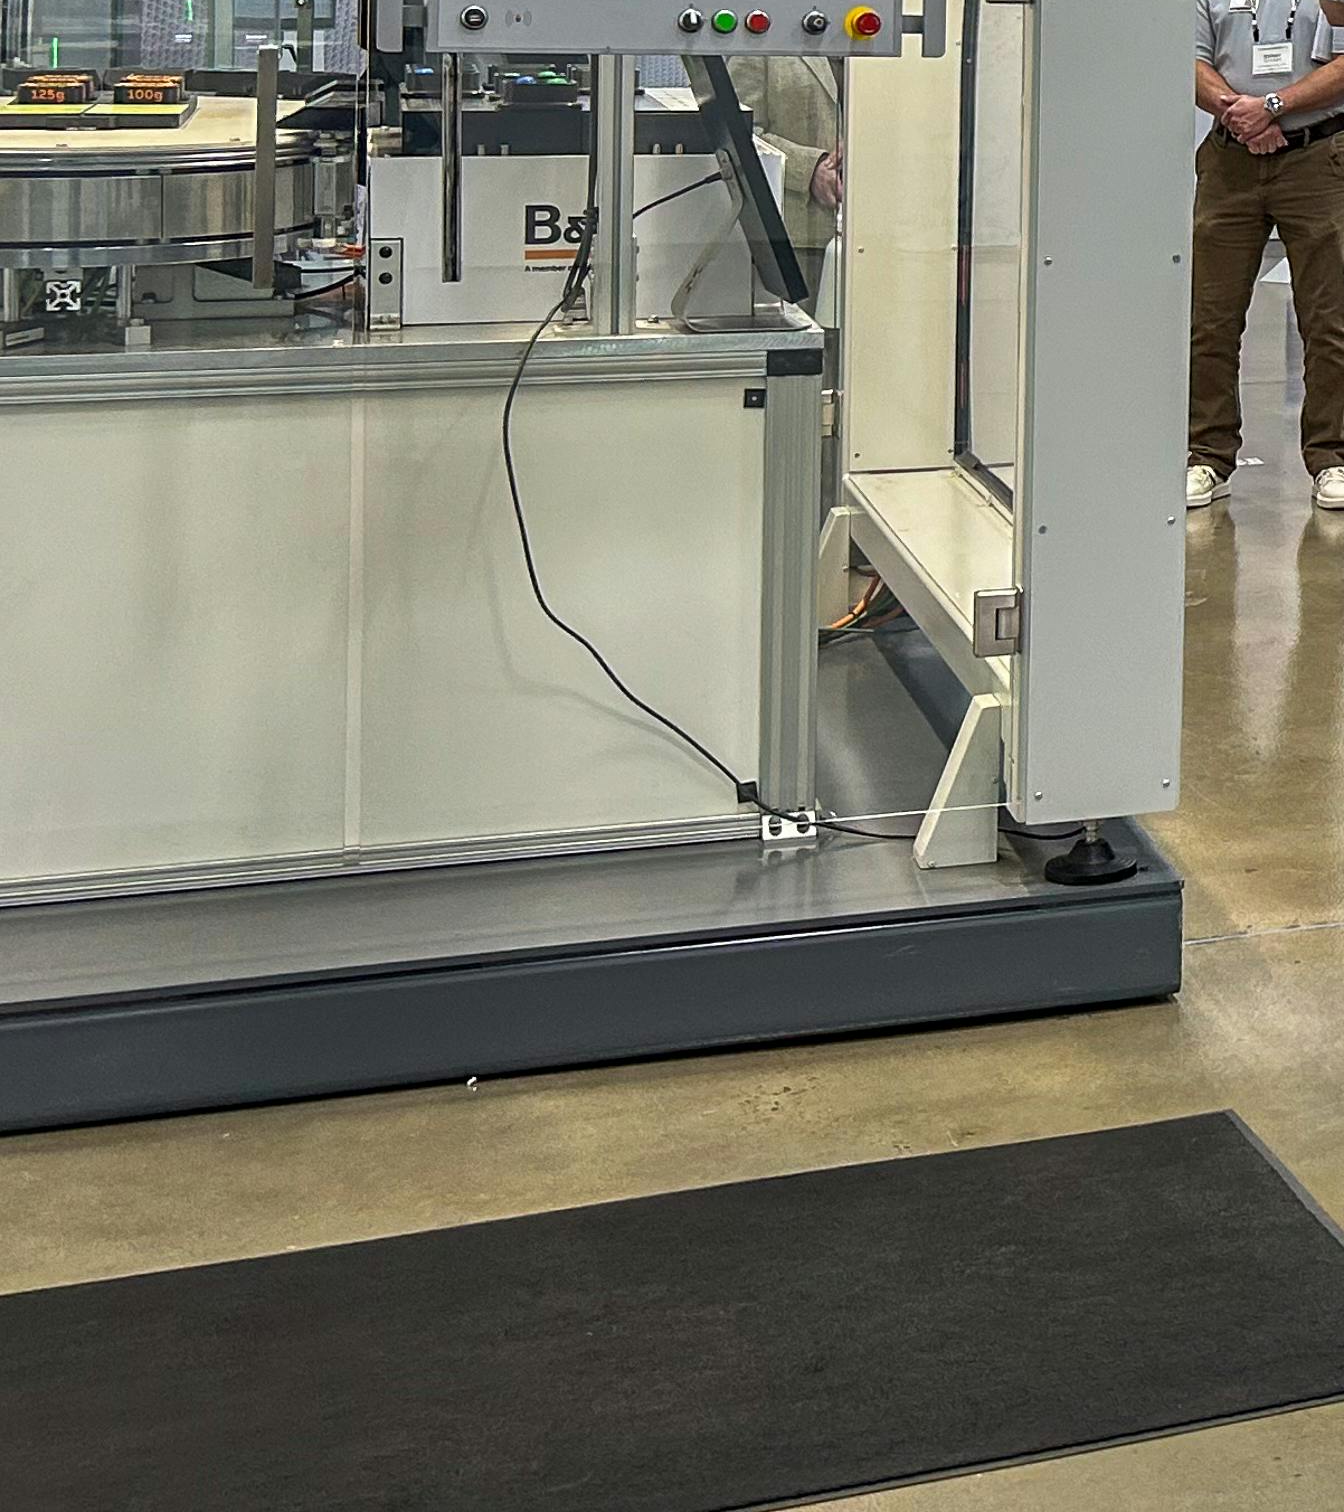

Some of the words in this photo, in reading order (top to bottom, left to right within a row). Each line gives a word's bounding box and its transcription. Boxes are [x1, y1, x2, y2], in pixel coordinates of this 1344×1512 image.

[31, 89, 65, 103] 125g
[127, 89, 163, 102] 100g
[525, 205, 590, 244] B&
